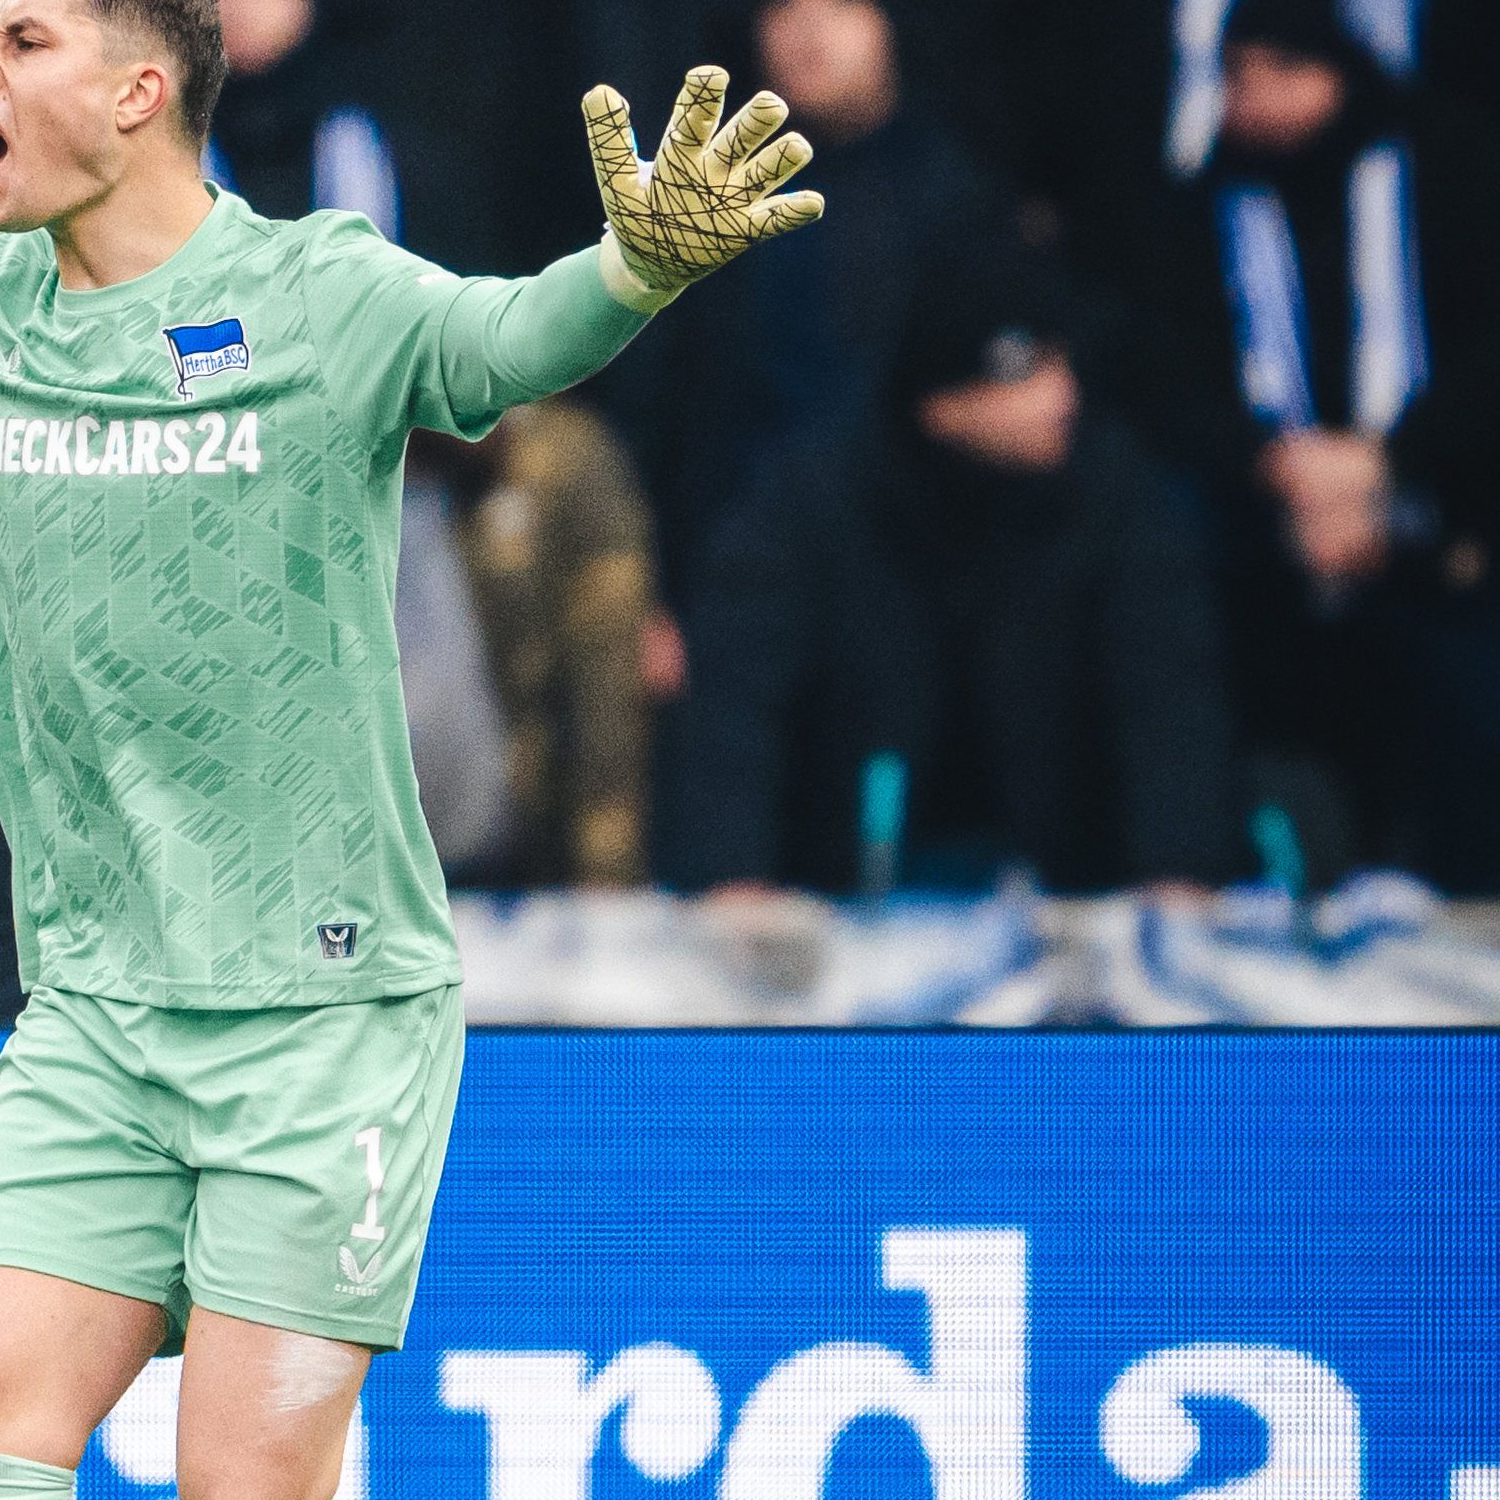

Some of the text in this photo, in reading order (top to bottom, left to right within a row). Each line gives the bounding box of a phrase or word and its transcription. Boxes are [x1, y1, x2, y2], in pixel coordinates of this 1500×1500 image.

[184, 346, 245, 375] Hertha BSC
[350, 1126, 386, 1242] 1
